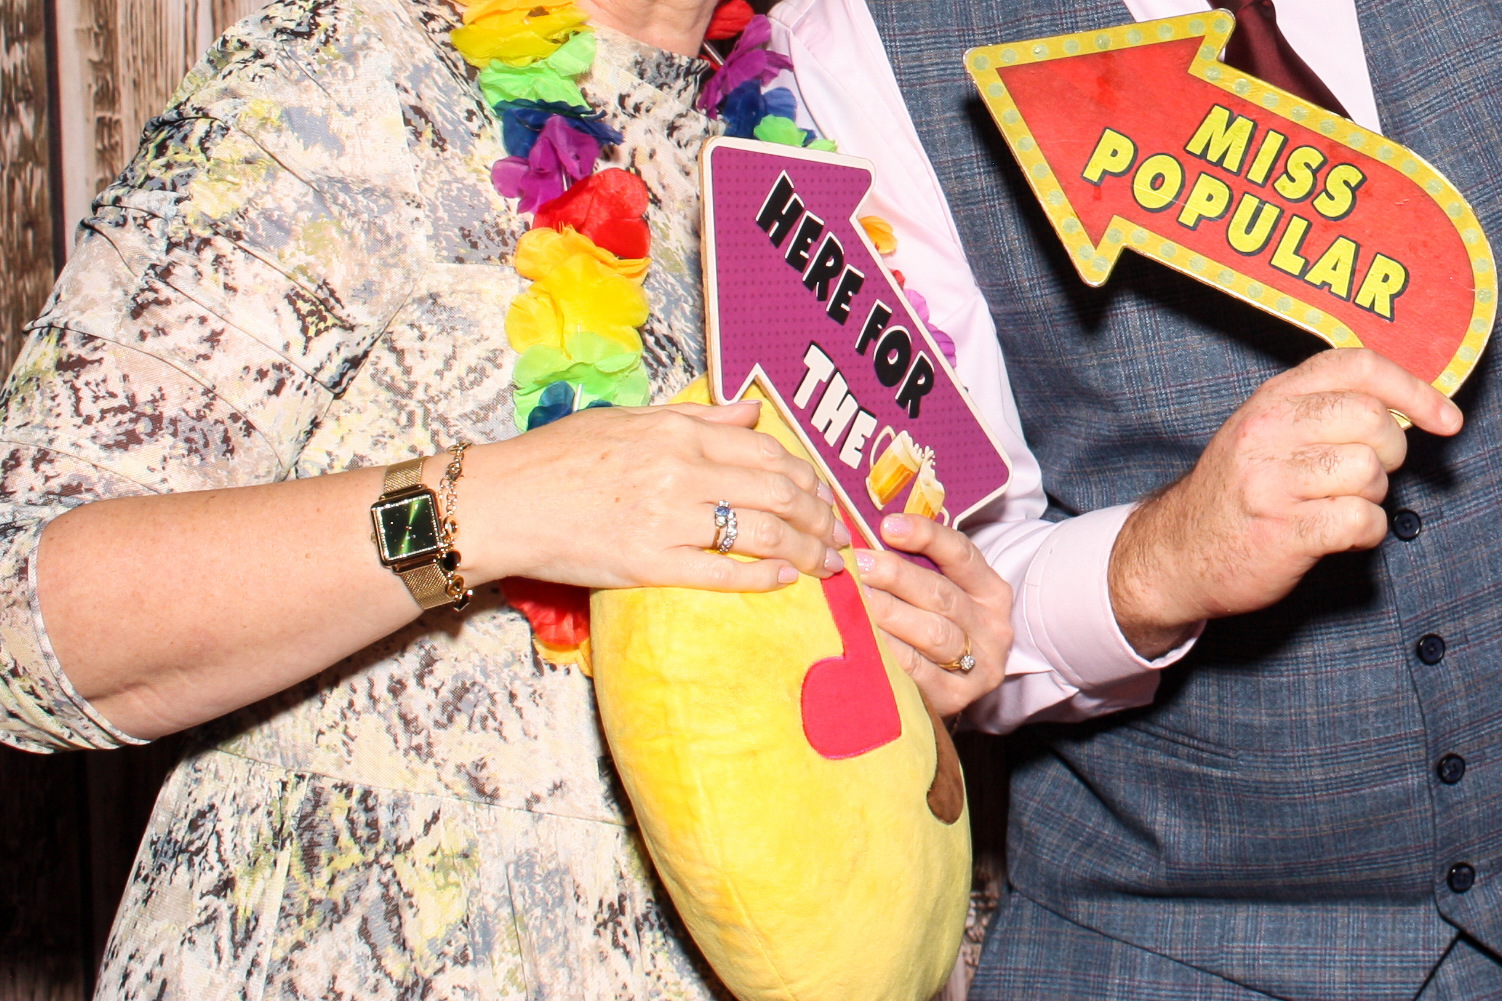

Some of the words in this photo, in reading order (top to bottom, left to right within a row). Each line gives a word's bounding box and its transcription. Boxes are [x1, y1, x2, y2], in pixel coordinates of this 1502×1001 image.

[1081, 127, 1409, 322] POPULAR
[1184, 103, 1366, 222] MISS
[755, 169, 865, 326] HERE
[855, 299, 935, 419] FOR
[793, 341, 878, 469] THE
